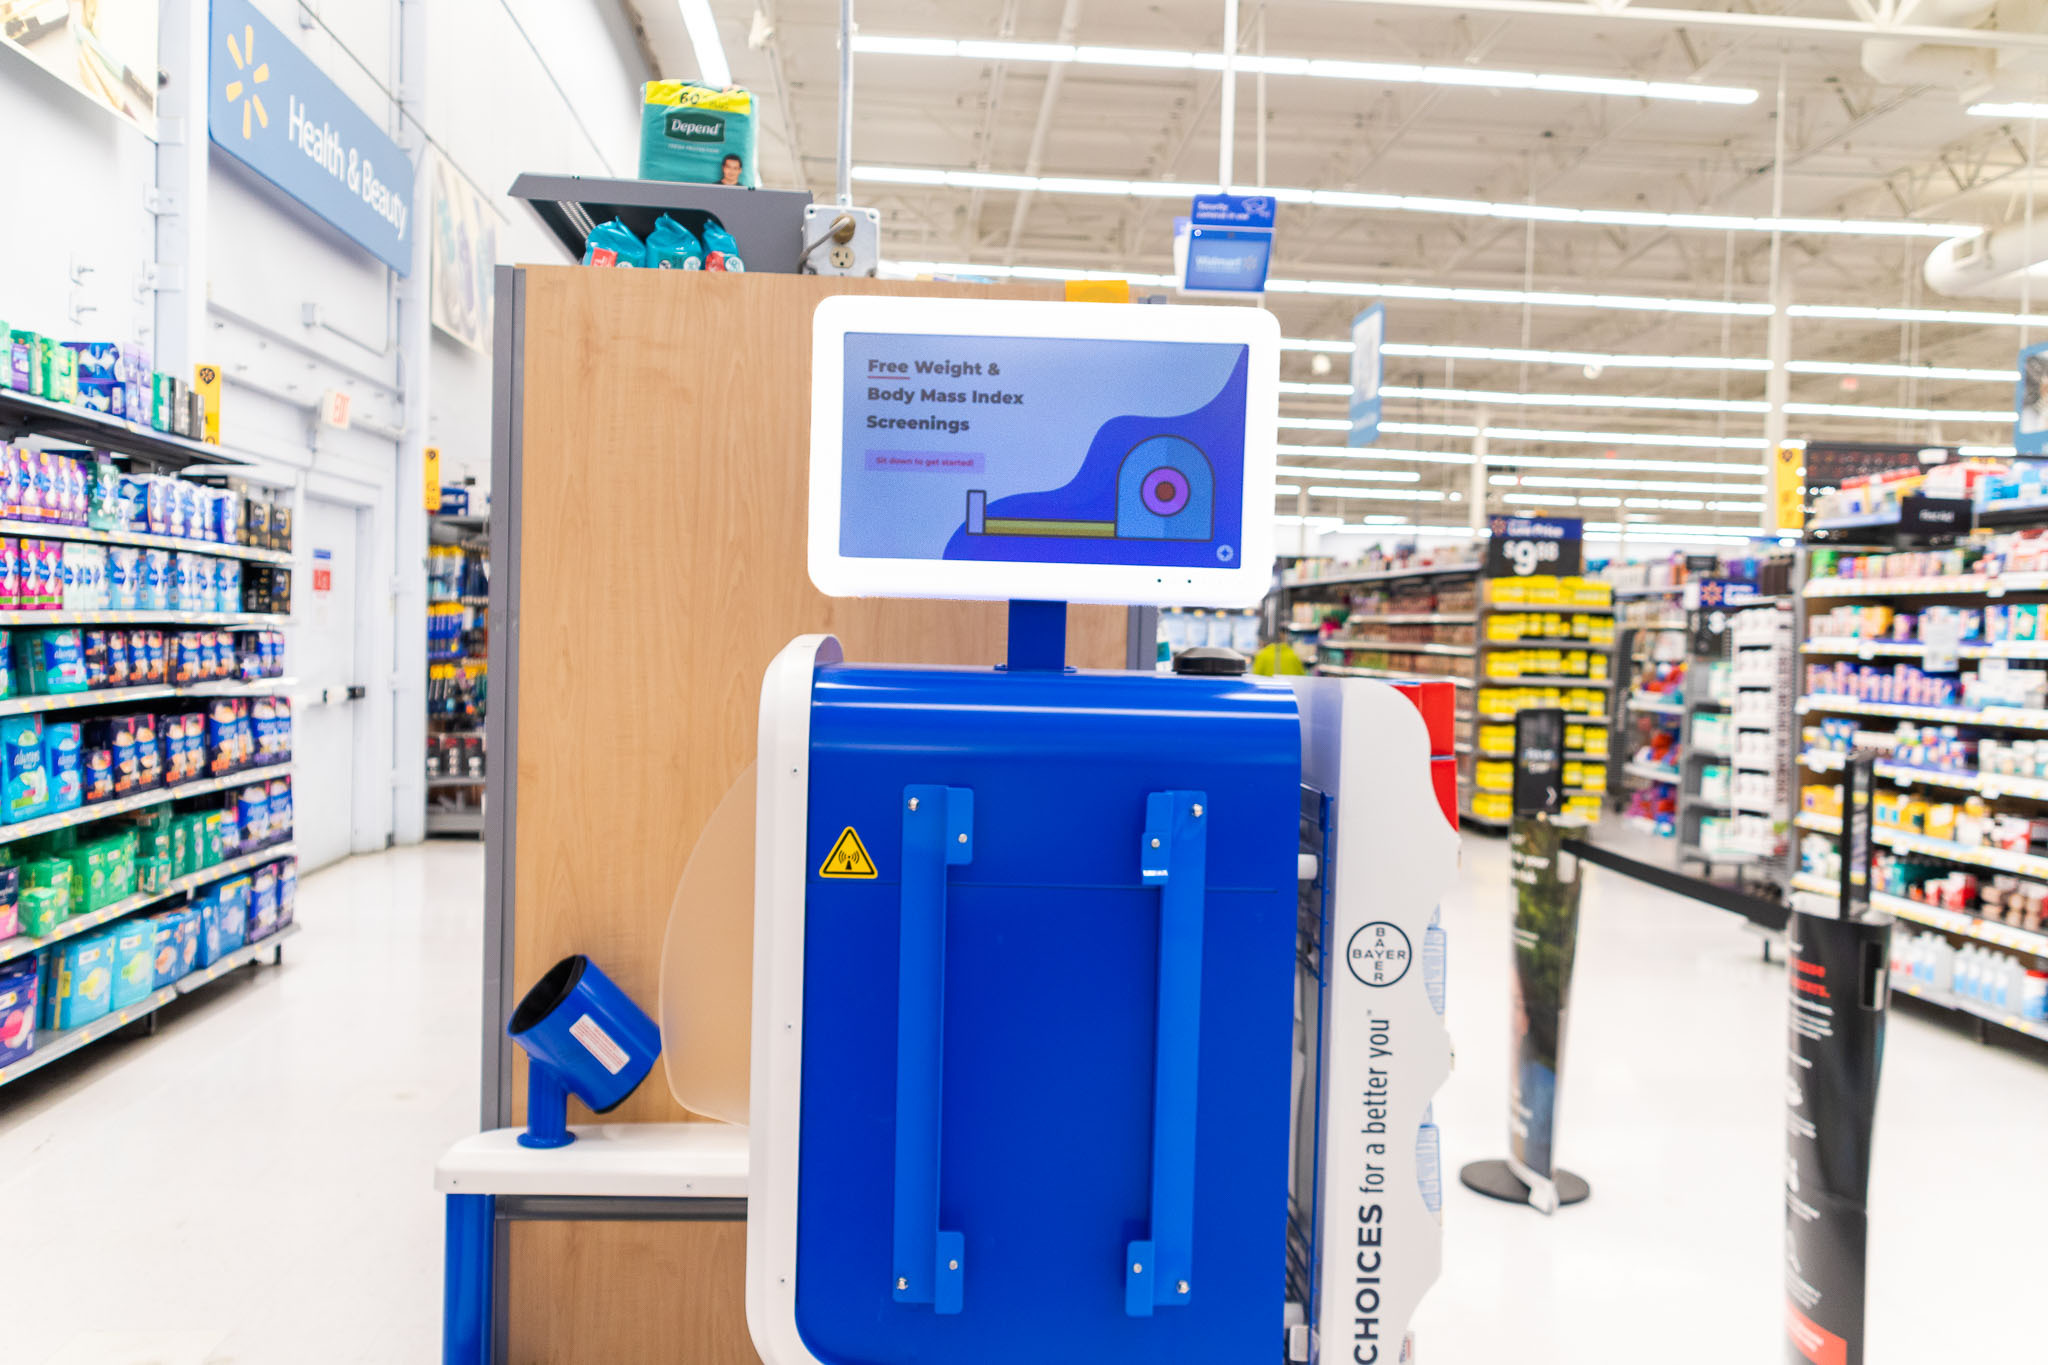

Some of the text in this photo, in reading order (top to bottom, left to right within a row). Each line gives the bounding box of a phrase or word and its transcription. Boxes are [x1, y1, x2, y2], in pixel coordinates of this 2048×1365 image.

[671, 118, 721, 136] Depend
[288, 95, 407, 241] Health & Beauty
[868, 359, 1001, 378] Free Weight &
[867, 387, 1024, 405] Body Mass Index
[866, 415, 970, 434] Screenings
[875, 457, 887, 465] Sit
[889, 457, 913, 465] down
[914, 458, 923, 466] to
[925, 459, 940, 468] get
[1352, 948, 1407, 960] BAYER
[1374, 927, 1386, 982] BAYER
[1353, 1018, 1393, 1365] CHOICES for a better you
